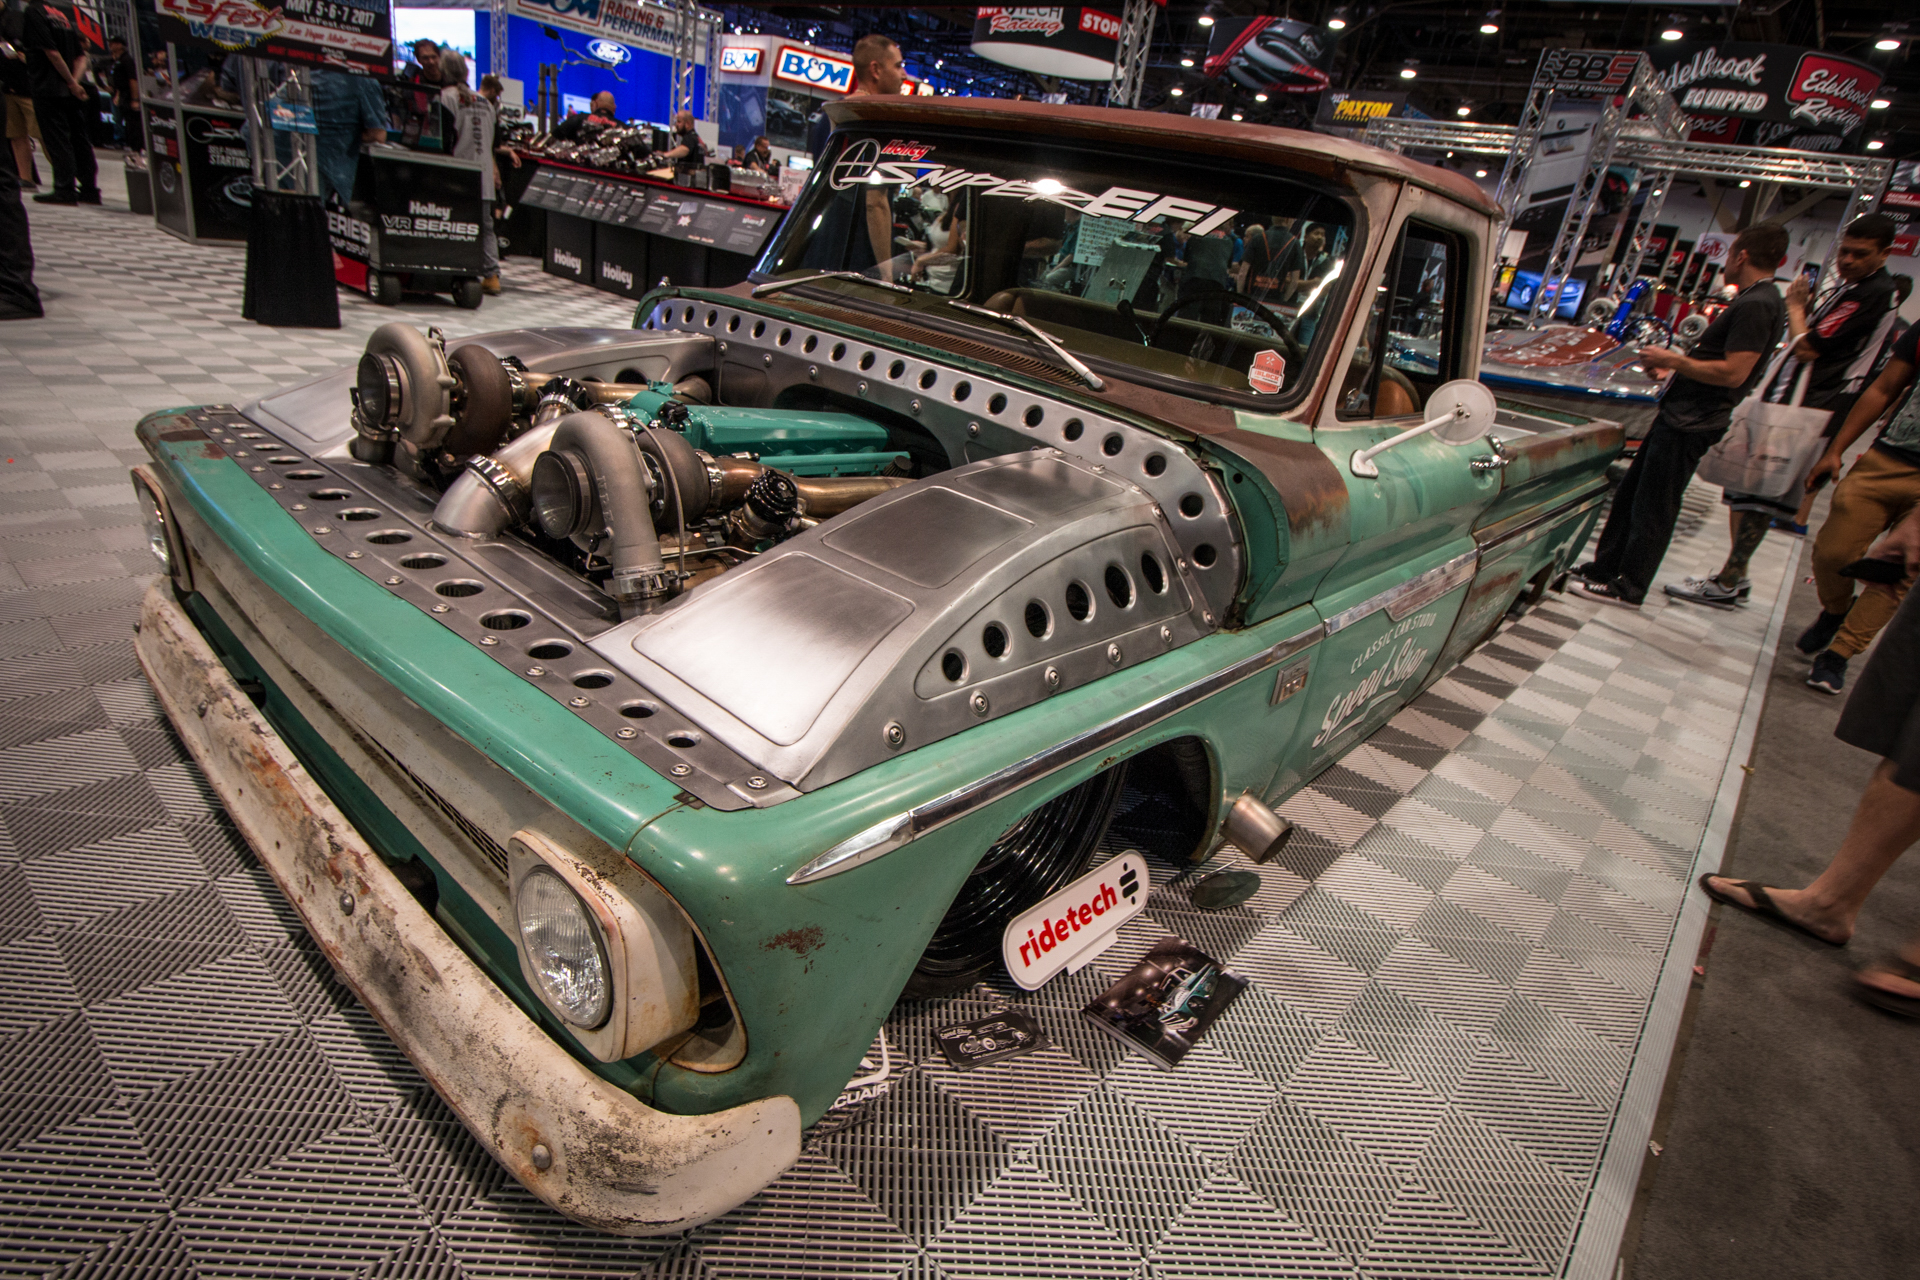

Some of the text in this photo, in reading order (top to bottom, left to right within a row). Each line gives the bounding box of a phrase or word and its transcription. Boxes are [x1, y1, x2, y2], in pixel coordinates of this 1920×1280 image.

[351, 8, 375, 27] 2017
[606, 1, 655, 26] RACING
[990, 15, 1062, 36] Racing
[190, 20, 262, 47] WEST
[723, 52, 758, 69] B&M
[781, 53, 851, 87] B&M
[1681, 88, 1769, 113] EQUIPPED
[1801, 69, 1874, 109] Edelbrock
[1335, 100, 1394, 118] PAXTON
[1791, 98, 1866, 138] Racing
[881, 138, 937, 161] Holley
[409, 200, 451, 221] Holley
[1085, 186, 1240, 237] EFI
[381, 214, 479, 236] VR SERIES
[554, 247, 582, 275] Holley
[602, 261, 633, 290] Holley
[1350, 629, 1394, 675] CLASSIC
[1393, 620, 1412, 637] CAR
[1410, 612, 1438, 631] STUDIO
[1312, 635, 1429, 750] Speed Shop
[1019, 882, 1118, 968] ridetech
